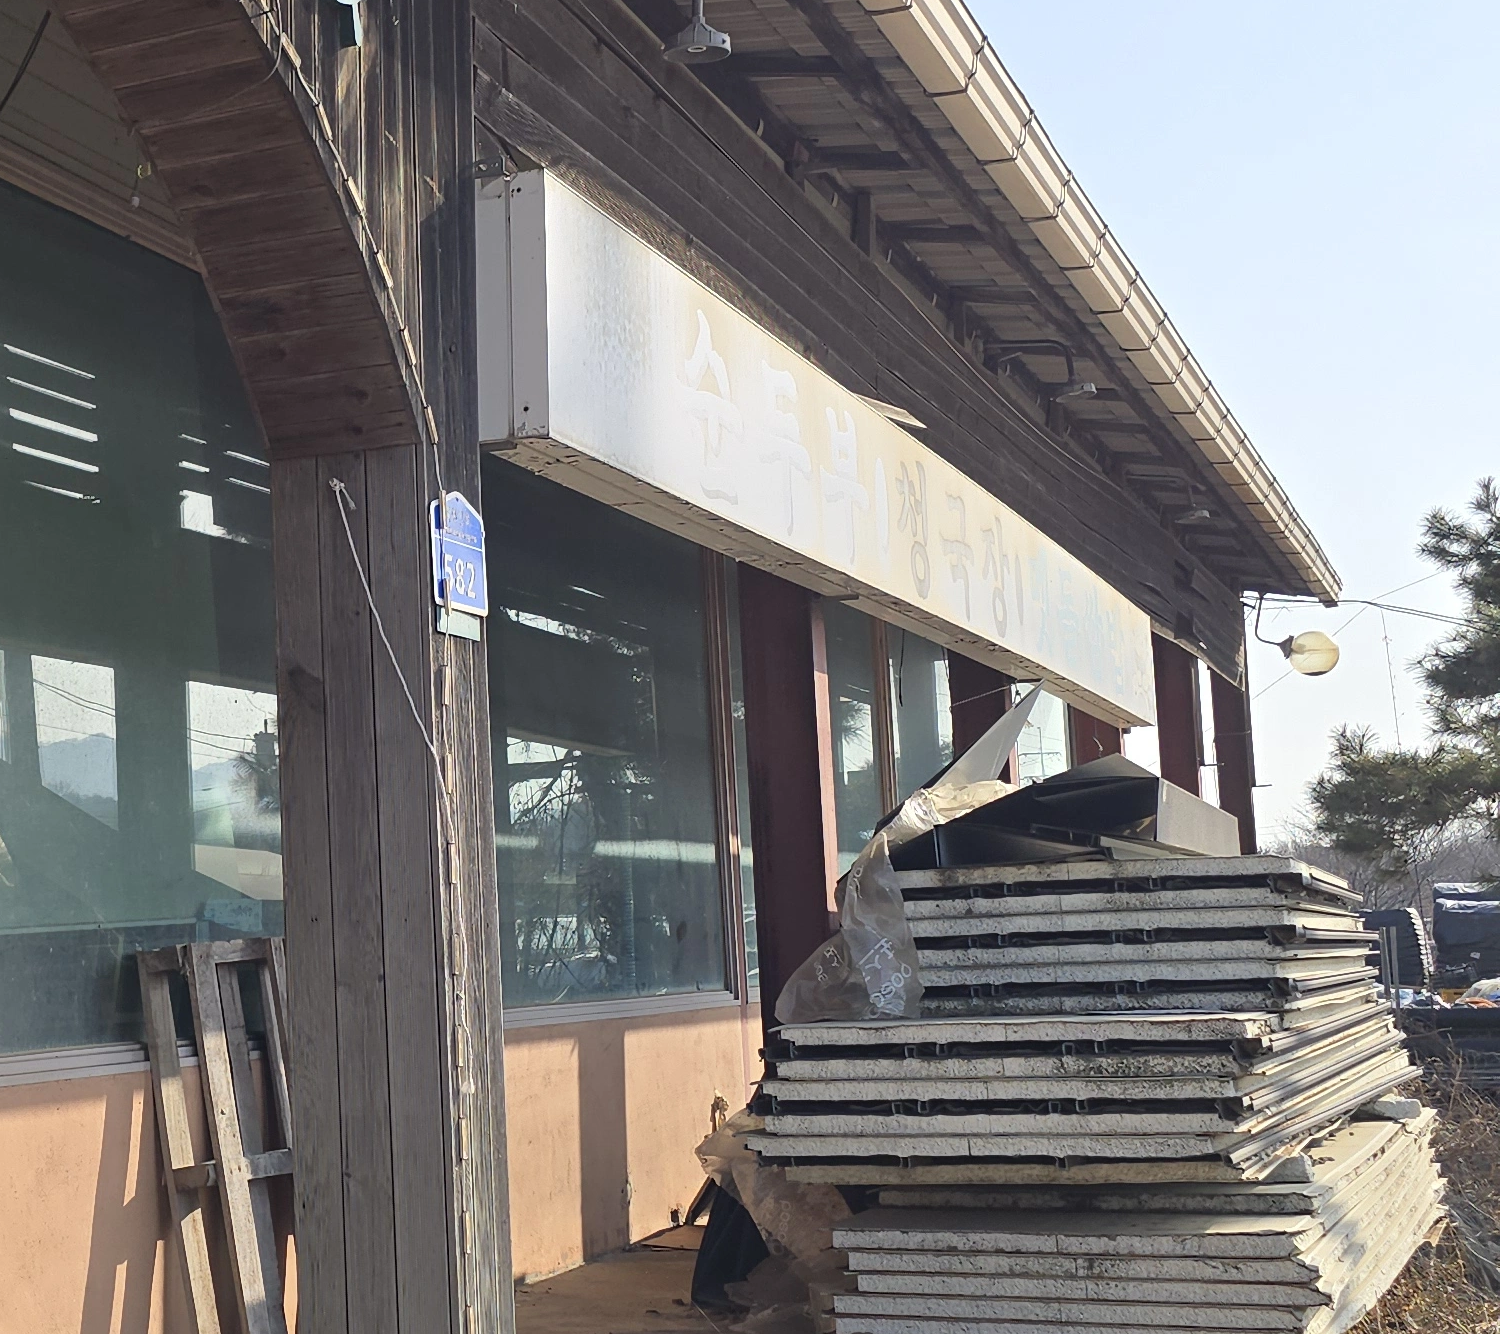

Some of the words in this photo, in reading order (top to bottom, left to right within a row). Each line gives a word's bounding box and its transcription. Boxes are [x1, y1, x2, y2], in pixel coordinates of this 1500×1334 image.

[681, 308, 871, 564] 순두부
[895, 458, 1009, 639] 청국장
[444, 554, 476, 599] 582
